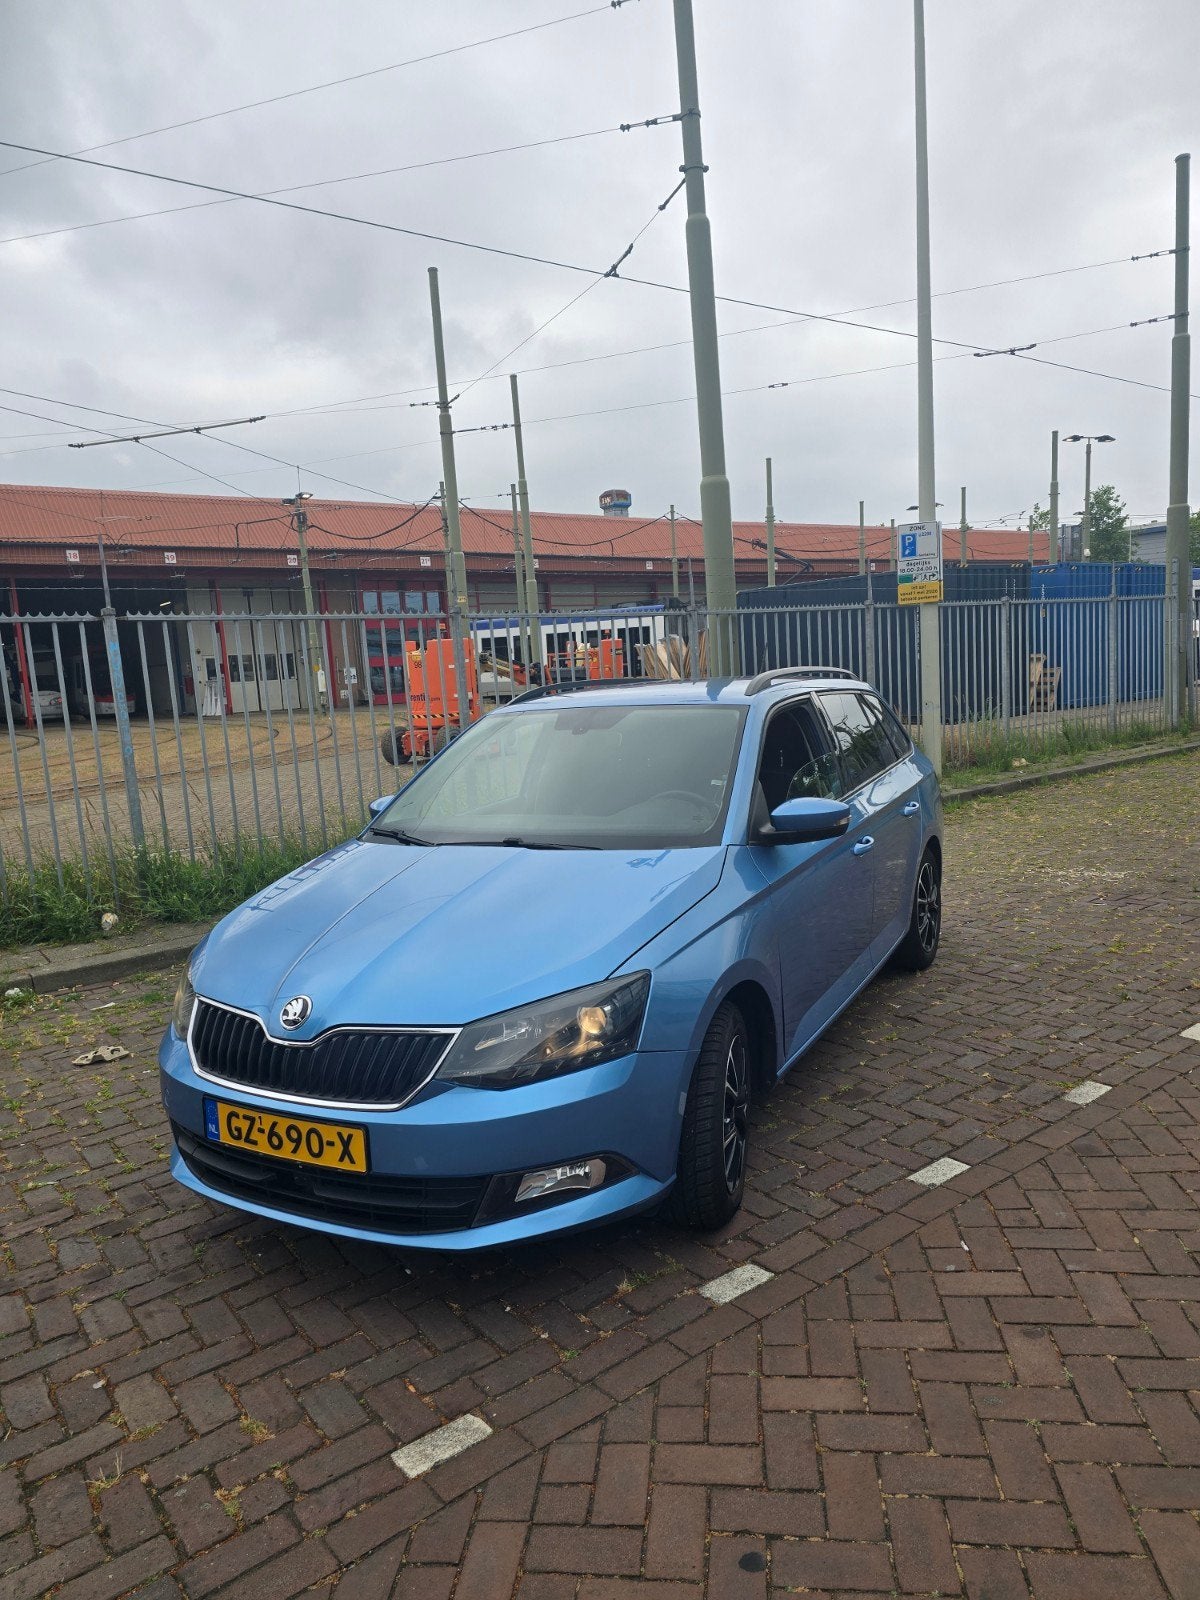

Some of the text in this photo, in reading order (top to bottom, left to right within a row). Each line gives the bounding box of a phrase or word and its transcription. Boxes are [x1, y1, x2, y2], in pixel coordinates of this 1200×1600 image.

[905, 535, 913, 546] P
[67, 552, 78, 560] 18
[905, 560, 931, 568] dagelijks
[208, 1122, 219, 1134] NL
[226, 1110, 356, 1165] GZ-690-X
